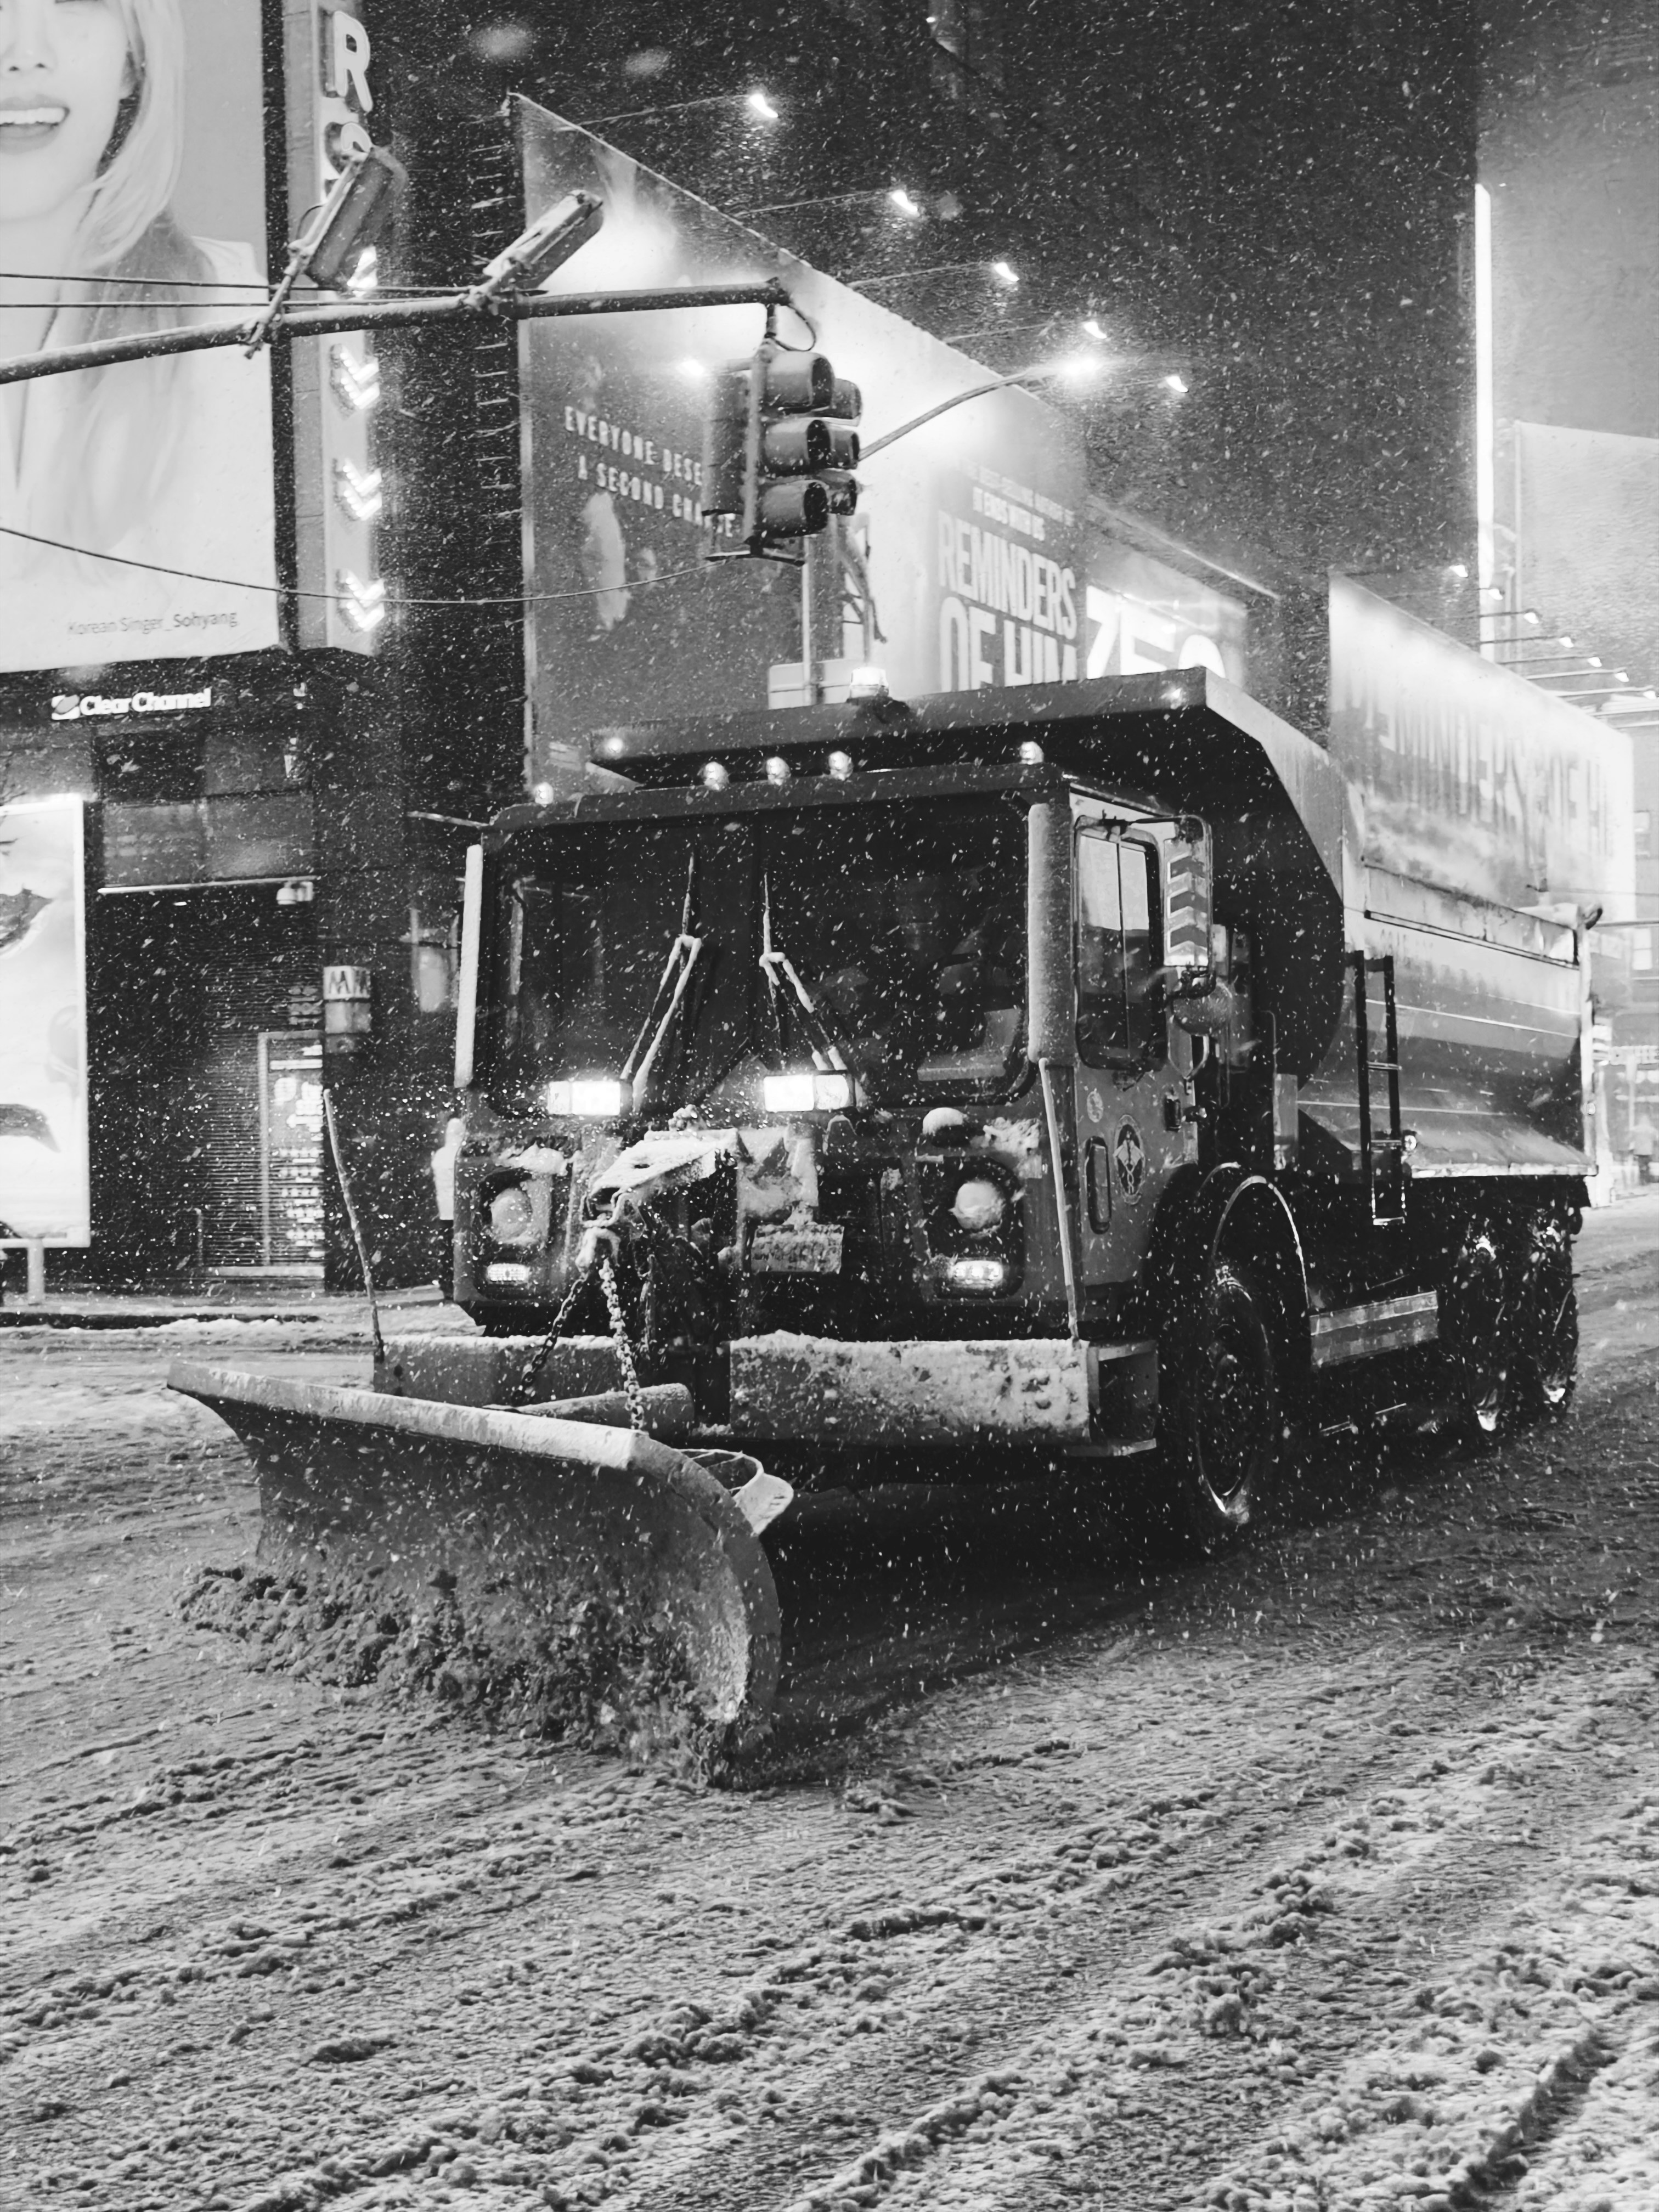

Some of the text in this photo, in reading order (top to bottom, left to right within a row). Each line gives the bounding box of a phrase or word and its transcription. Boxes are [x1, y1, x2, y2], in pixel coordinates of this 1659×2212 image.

[565, 405, 655, 465] EVERYONE
[596, 462, 664, 510] SECOND
[938, 509, 1077, 640] REMINDERS
[940, 596, 996, 692] OF
[79, 687, 212, 716] Clear Channel
